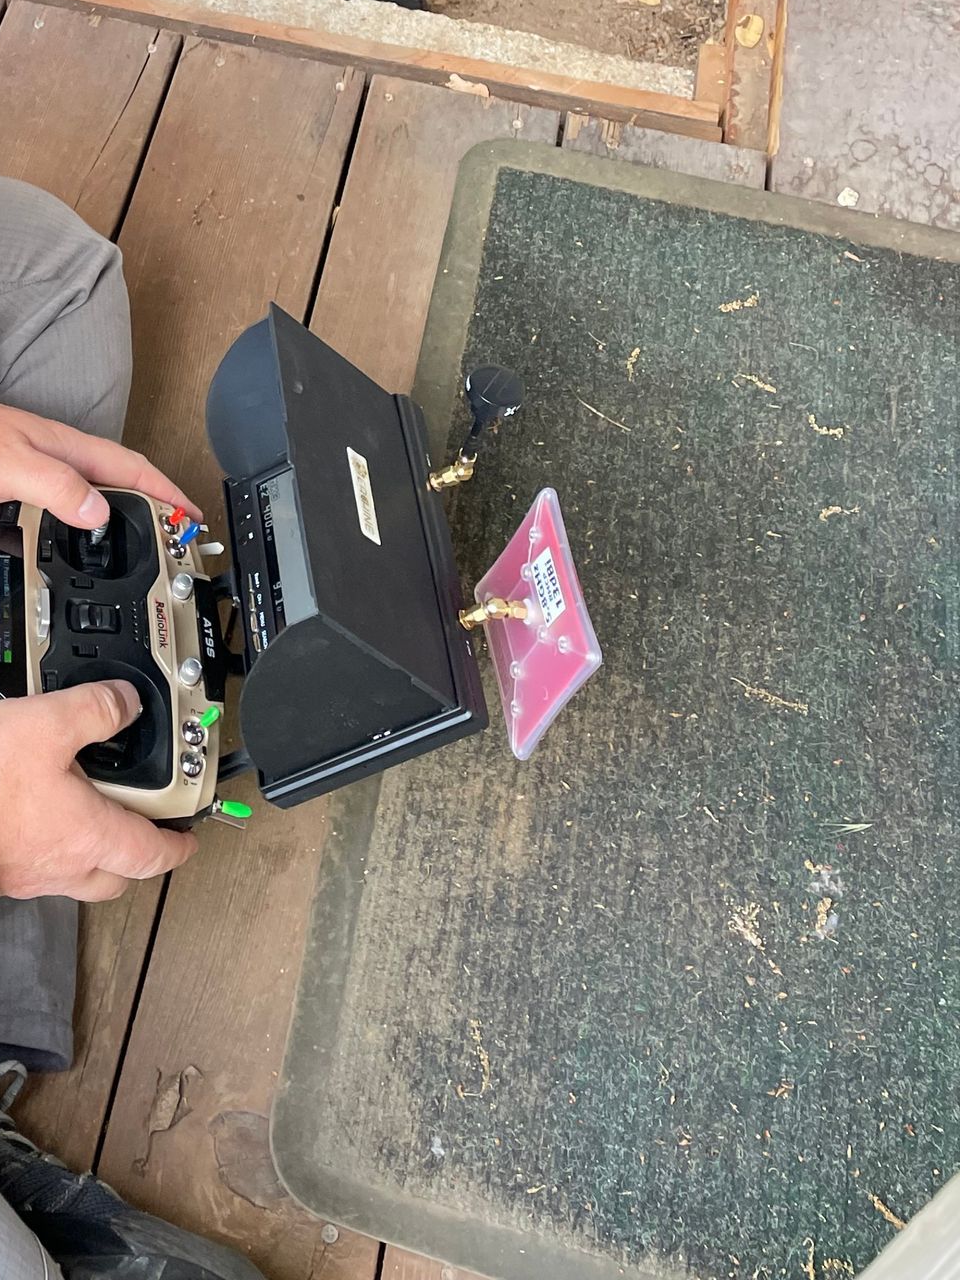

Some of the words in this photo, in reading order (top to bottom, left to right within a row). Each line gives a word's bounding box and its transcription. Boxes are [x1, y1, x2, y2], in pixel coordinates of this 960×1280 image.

[533, 563, 552, 623] 5.8GHz
[544, 558, 562, 608] 13dBi
[155, 600, 168, 649] RadioLink
[202, 616, 215, 658] AT9S
